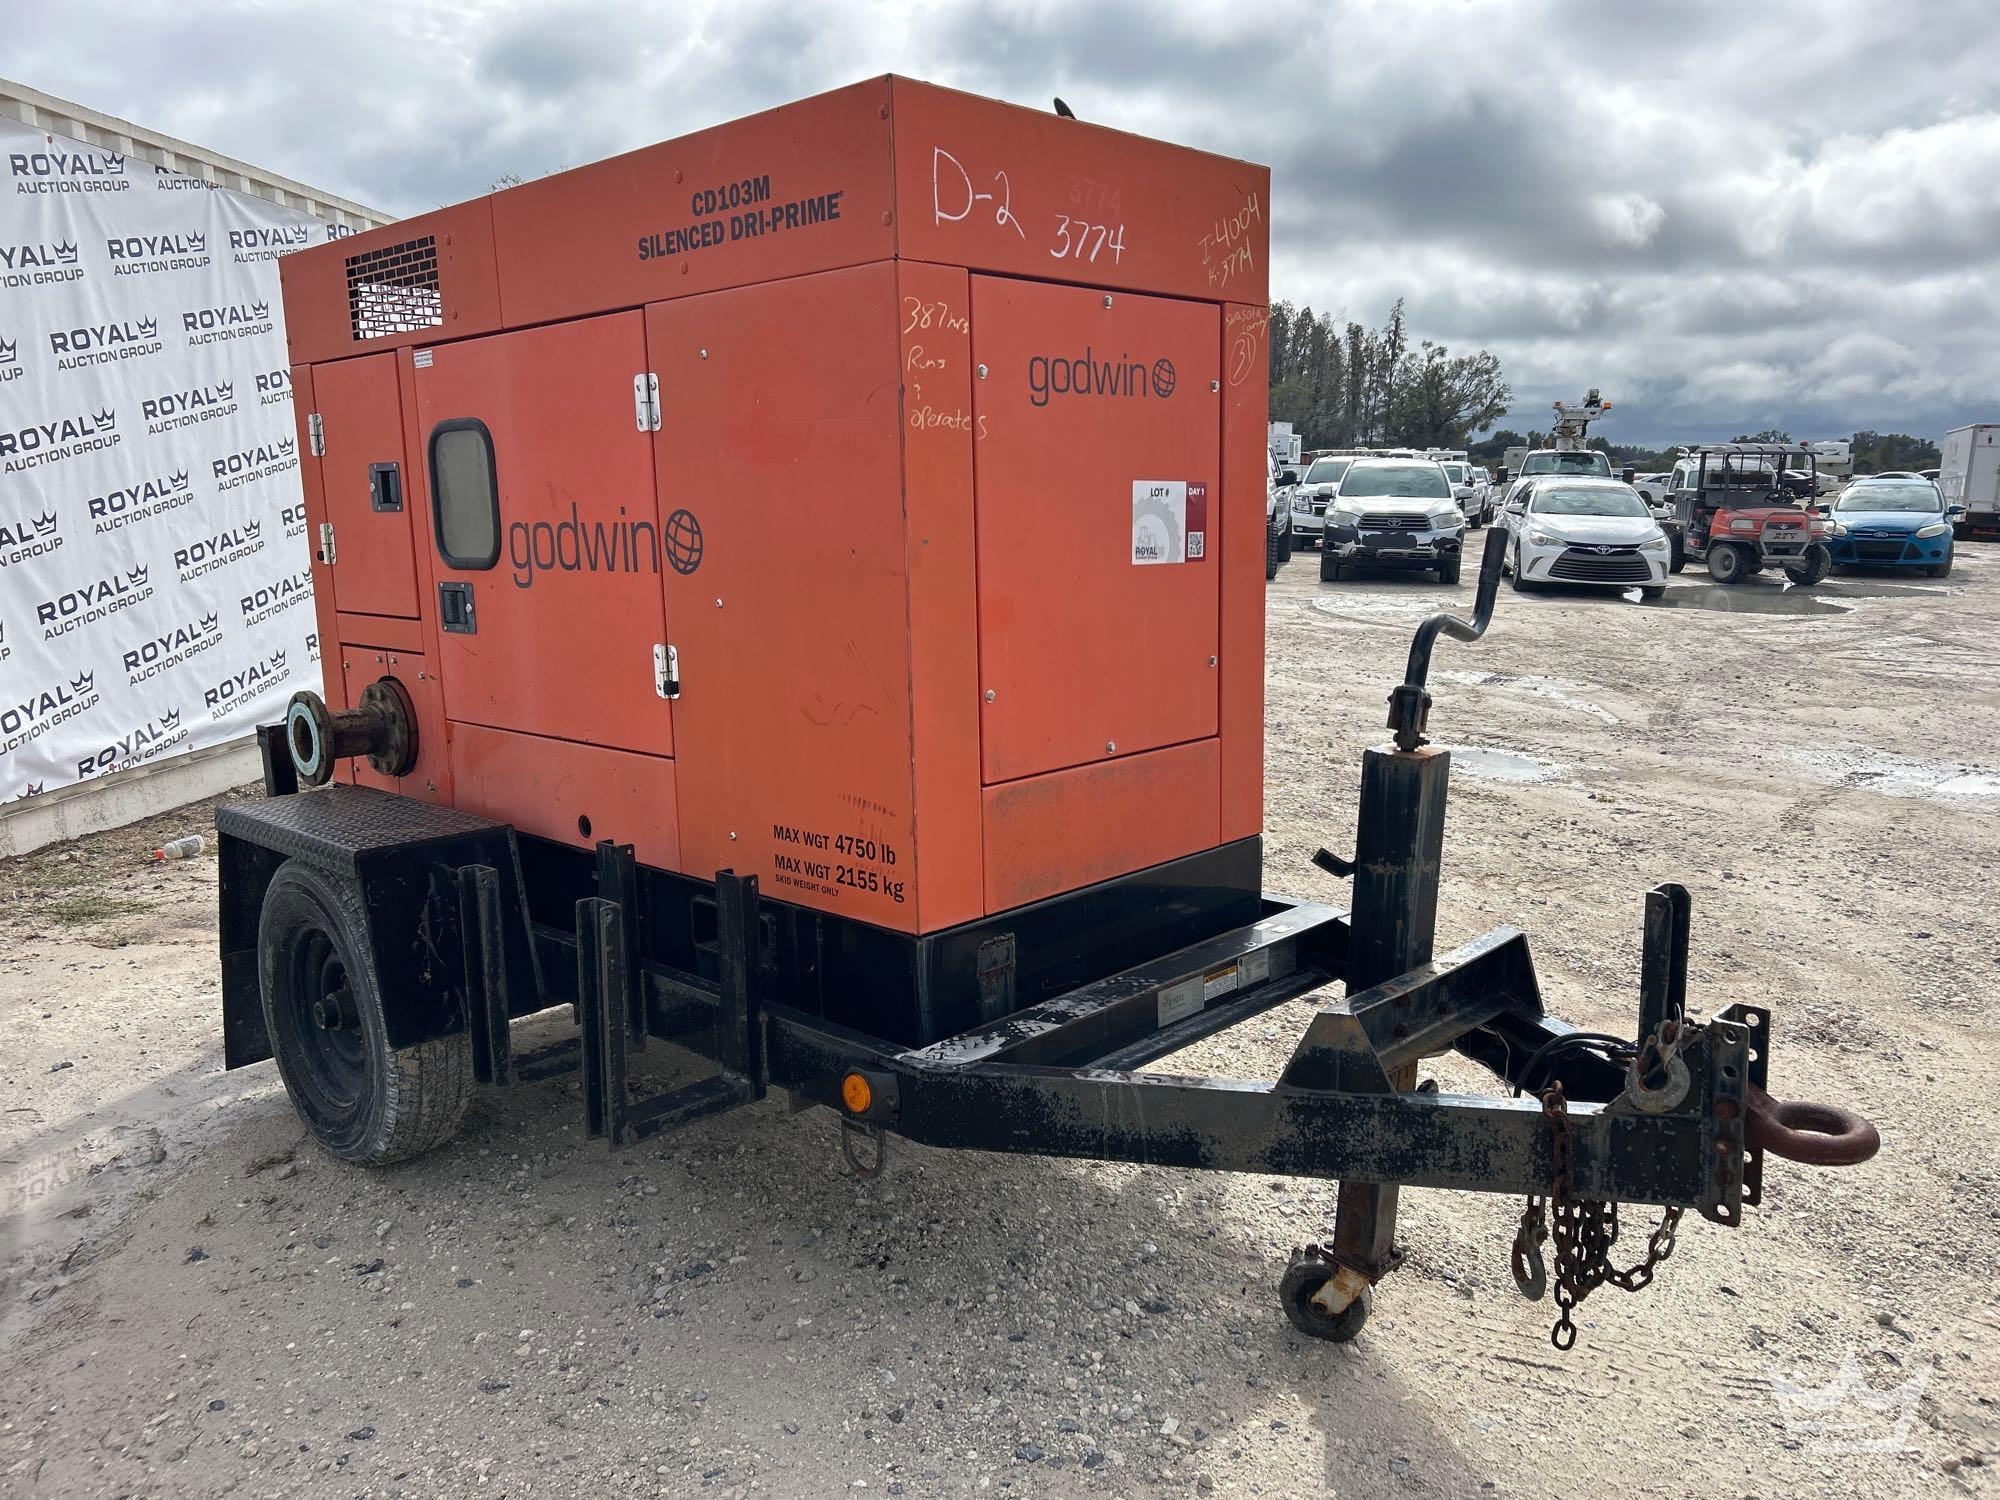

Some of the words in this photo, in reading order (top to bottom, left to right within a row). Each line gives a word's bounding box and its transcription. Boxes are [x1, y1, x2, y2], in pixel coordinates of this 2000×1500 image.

[10, 153, 103, 176] ROYAL
[16, 180, 82, 195] AUCTION
[83, 179, 130, 192] GROUP
[157, 179, 209, 190] AUCTION
[692, 175, 771, 217] CD103M
[933, 146, 1026, 240] D-2
[107, 235, 188, 259] ROYAL
[229, 227, 294, 249] ROYAL
[638, 220, 725, 261] SILENCED
[1050, 214, 1125, 264] 3774
[0, 244, 55, 269] YAL
[114, 260, 168, 276] AUCTION
[170, 256, 211, 270] GROUP
[233, 250, 278, 263] AUCTION
[34, 268, 84, 285] GROUP
[182, 304, 253, 332] ROYAL
[188, 329, 237, 346] AUCTION
[237, 323, 273, 338] GROUP
[49, 322, 139, 354] ROYAL
[58, 349, 118, 371] AUCTION
[119, 342, 162, 359] GROUP
[1029, 347, 1147, 407] godwin
[142, 387, 217, 420] ROYAL
[260, 390, 294, 406] AUCTIO
[148, 413, 199, 435] AUCTION
[200, 403, 238, 421] GROUP
[0, 416, 94, 457] ROYAL
[5, 446, 71, 474] AUCTION
[73, 433, 121, 455] GROUP
[212, 444, 279, 478] ROYAL
[218, 469, 264, 492] AUCTION
[264, 458, 298, 476] GROUP
[88, 478, 171, 519] ROYAL
[1150, 488, 1164, 497] LOT
[1188, 487, 1200, 496] DAY
[1201, 487, 1205, 496] 1
[95, 506, 151, 535] AUCTION
[153, 492, 194, 515] GROUP
[10, 537, 63, 564] GROUP
[173, 529, 245, 569] ROYAL
[180, 556, 228, 584] AUCTION
[229, 540, 265, 562] GROUP
[510, 502, 658, 589] godwin
[1135, 546, 1157, 556] ROYAL
[36, 575, 129, 625] ROYAL
[240, 575, 304, 615] ROYAL
[44, 606, 107, 641] AUCTION
[108, 587, 154, 613] GROUP
[246, 600, 289, 628] AUCTION
[122, 623, 201, 673] ROYAL
[129, 652, 184, 687] AUCTION
[185, 632, 223, 659] GROUP
[204, 661, 272, 709] ROYAL
[211, 688, 256, 721] AUCTION
[257, 668, 290, 694] GROUP
[0, 686, 73, 735] OYAL
[51, 693, 100, 726] GROUP
[77, 722, 164, 780] ROYAL
[144, 728, 189, 759] GROUP
[773, 825, 800, 844] MAX
[803, 831, 829, 850] WGT
[835, 834, 876, 860] 4750
[881, 843, 896, 866] lb
[774, 854, 801, 874] MAX
[804, 860, 830, 880] WGT
[836, 865, 879, 892] 2155
[883, 876, 905, 904] kg
[775, 874, 791, 885] SKID
[793, 880, 820, 892] WEIGHT
[821, 885, 840, 897] ONLY
